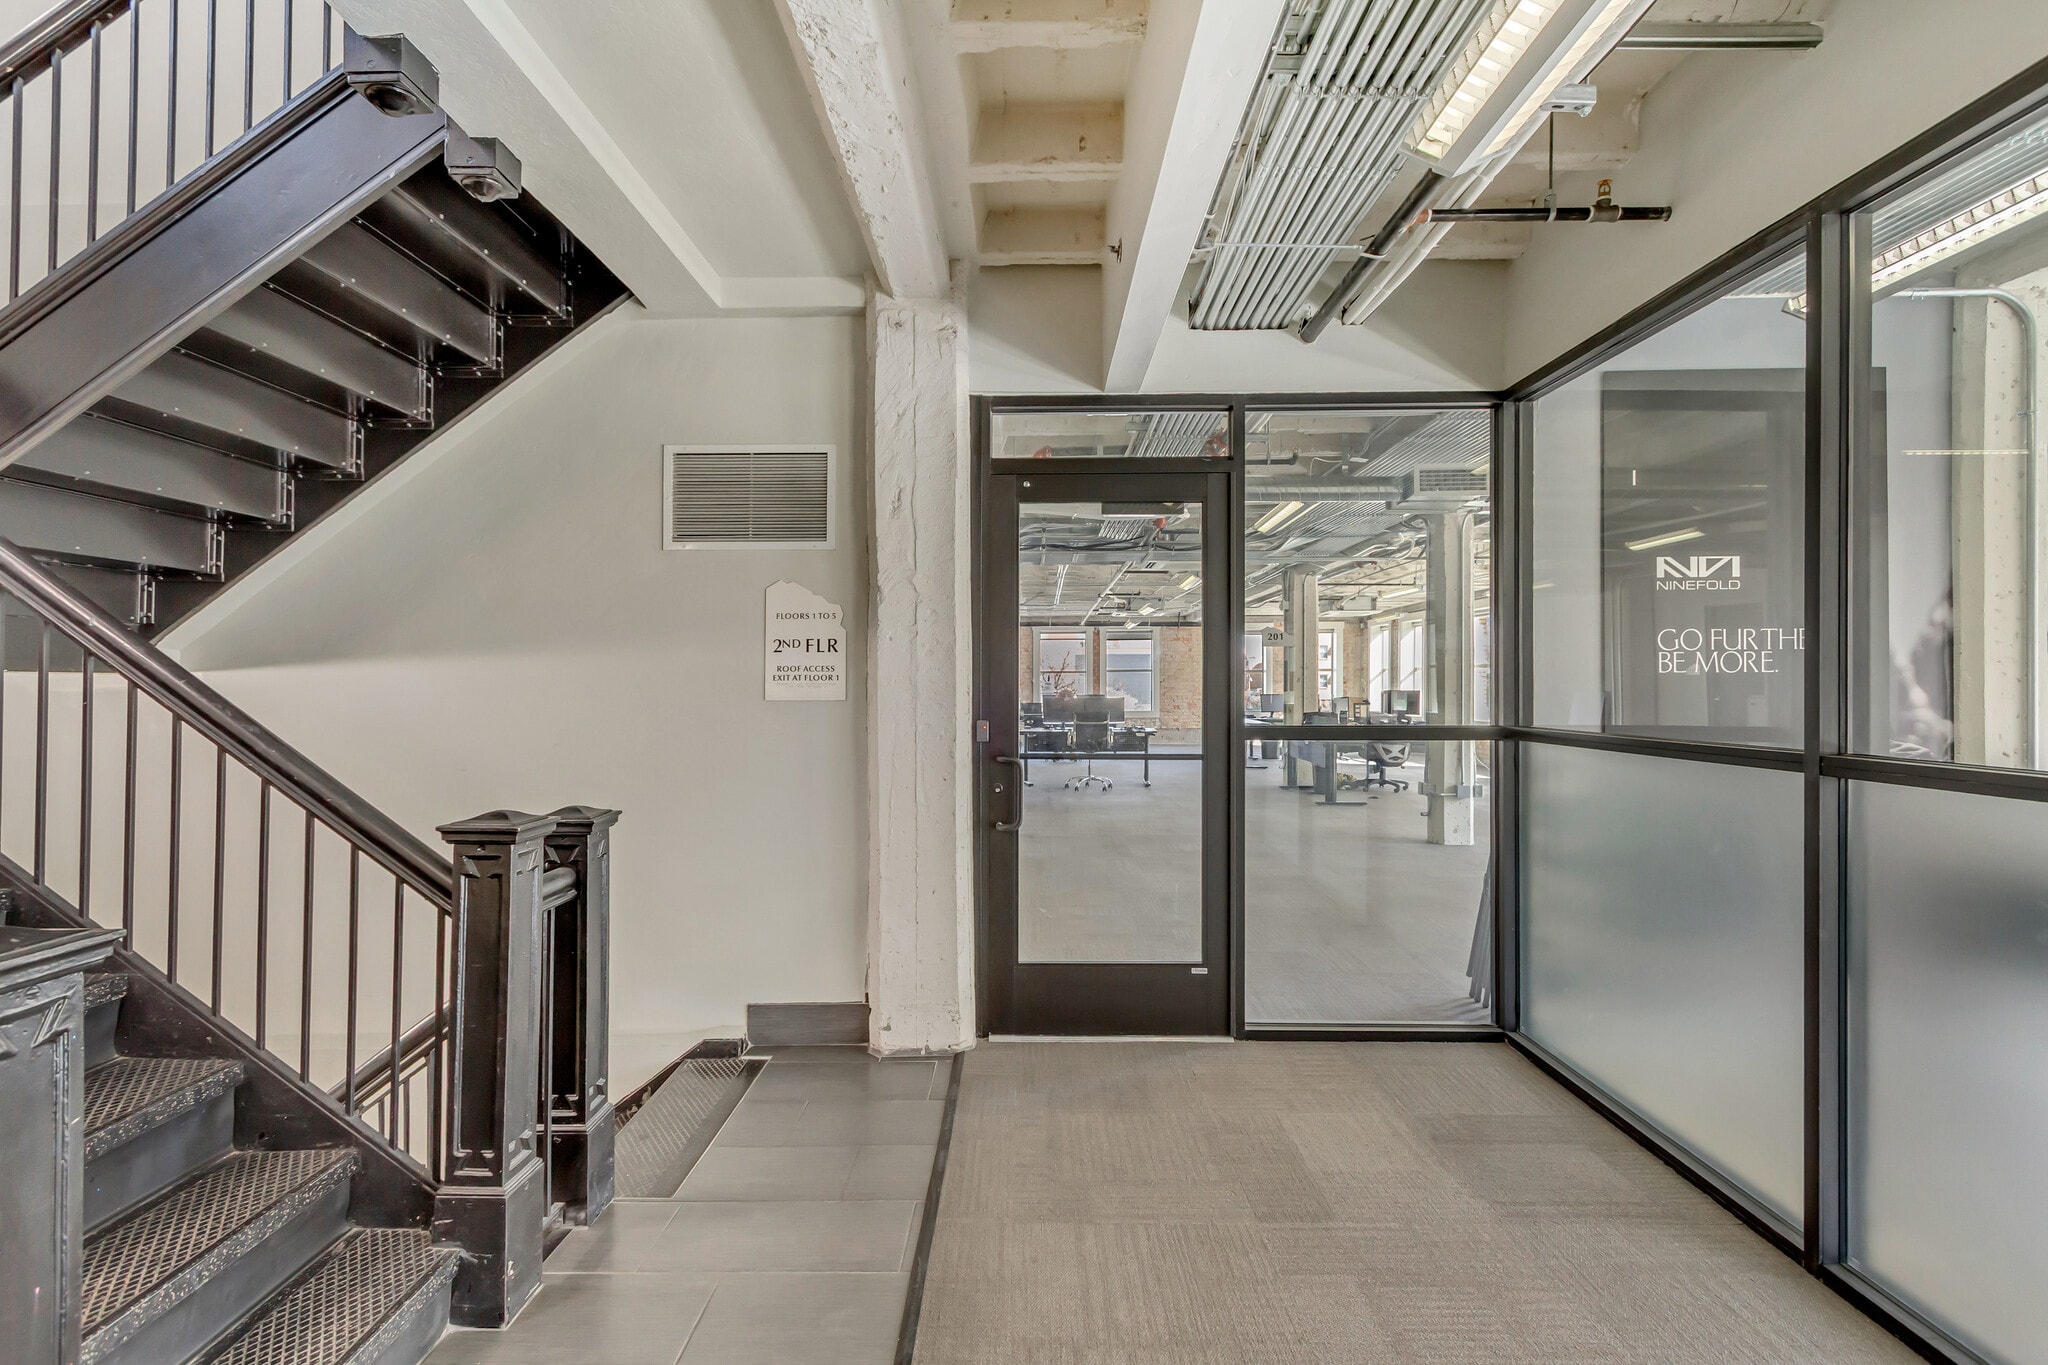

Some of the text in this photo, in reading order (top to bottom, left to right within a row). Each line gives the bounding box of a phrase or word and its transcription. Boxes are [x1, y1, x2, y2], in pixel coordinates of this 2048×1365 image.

[1656, 580, 1741, 591] NINEFOLD
[776, 612, 836, 620] FLOORS 1 TO 5
[1267, 632, 1284, 641] 201
[1657, 628, 1703, 651] GO
[773, 638, 839, 653] 2ND FLR
[1658, 651, 1779, 673] BE MORE.
[777, 665, 835, 673] ROOF ACCESS
[773, 674, 839, 682] EXIT AT FLOOR 1
